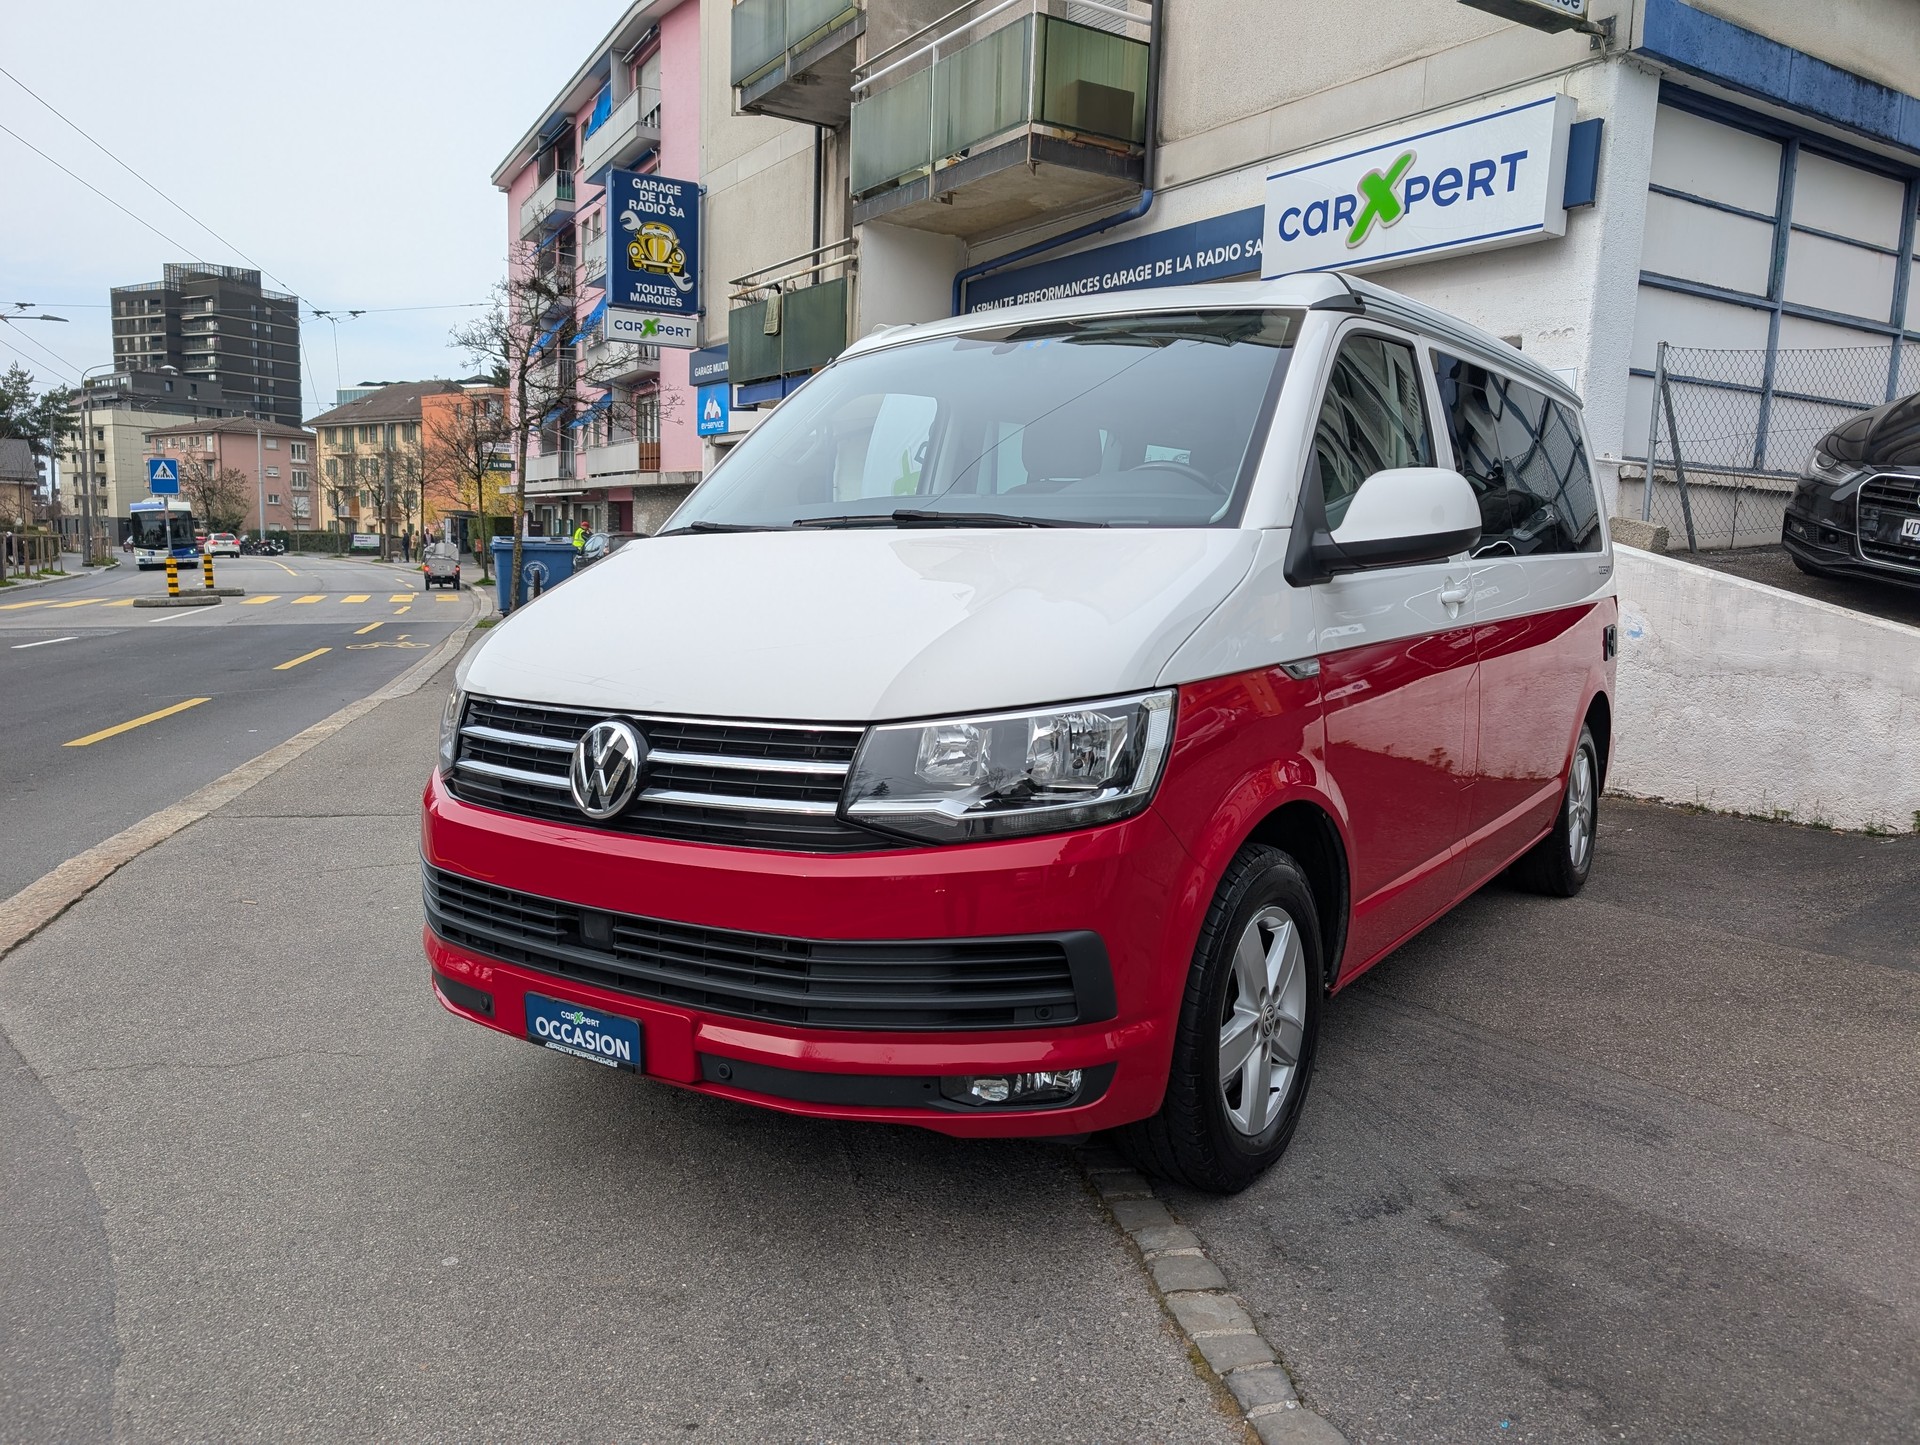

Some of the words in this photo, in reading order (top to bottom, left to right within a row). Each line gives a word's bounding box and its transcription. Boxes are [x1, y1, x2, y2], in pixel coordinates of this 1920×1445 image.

[632, 178, 682, 196] GARAGE
[639, 191, 657, 203] DE
[659, 193, 675, 206] LA
[628, 199, 666, 215] RADIO
[669, 206, 685, 218] SA
[1017, 277, 1100, 306] PERFORMANCES
[1103, 263, 1152, 289] GARAGE
[1155, 258, 1172, 277] DE
[1176, 252, 1192, 273] LA
[1196, 243, 1241, 268] RADIO
[1245, 238, 1263, 257] SA
[635, 282, 677, 297] TOUTES
[630, 291, 683, 308] MARQUES
[694, 364, 713, 377] GARAGE
[535, 1016, 630, 1061] OCCASION
